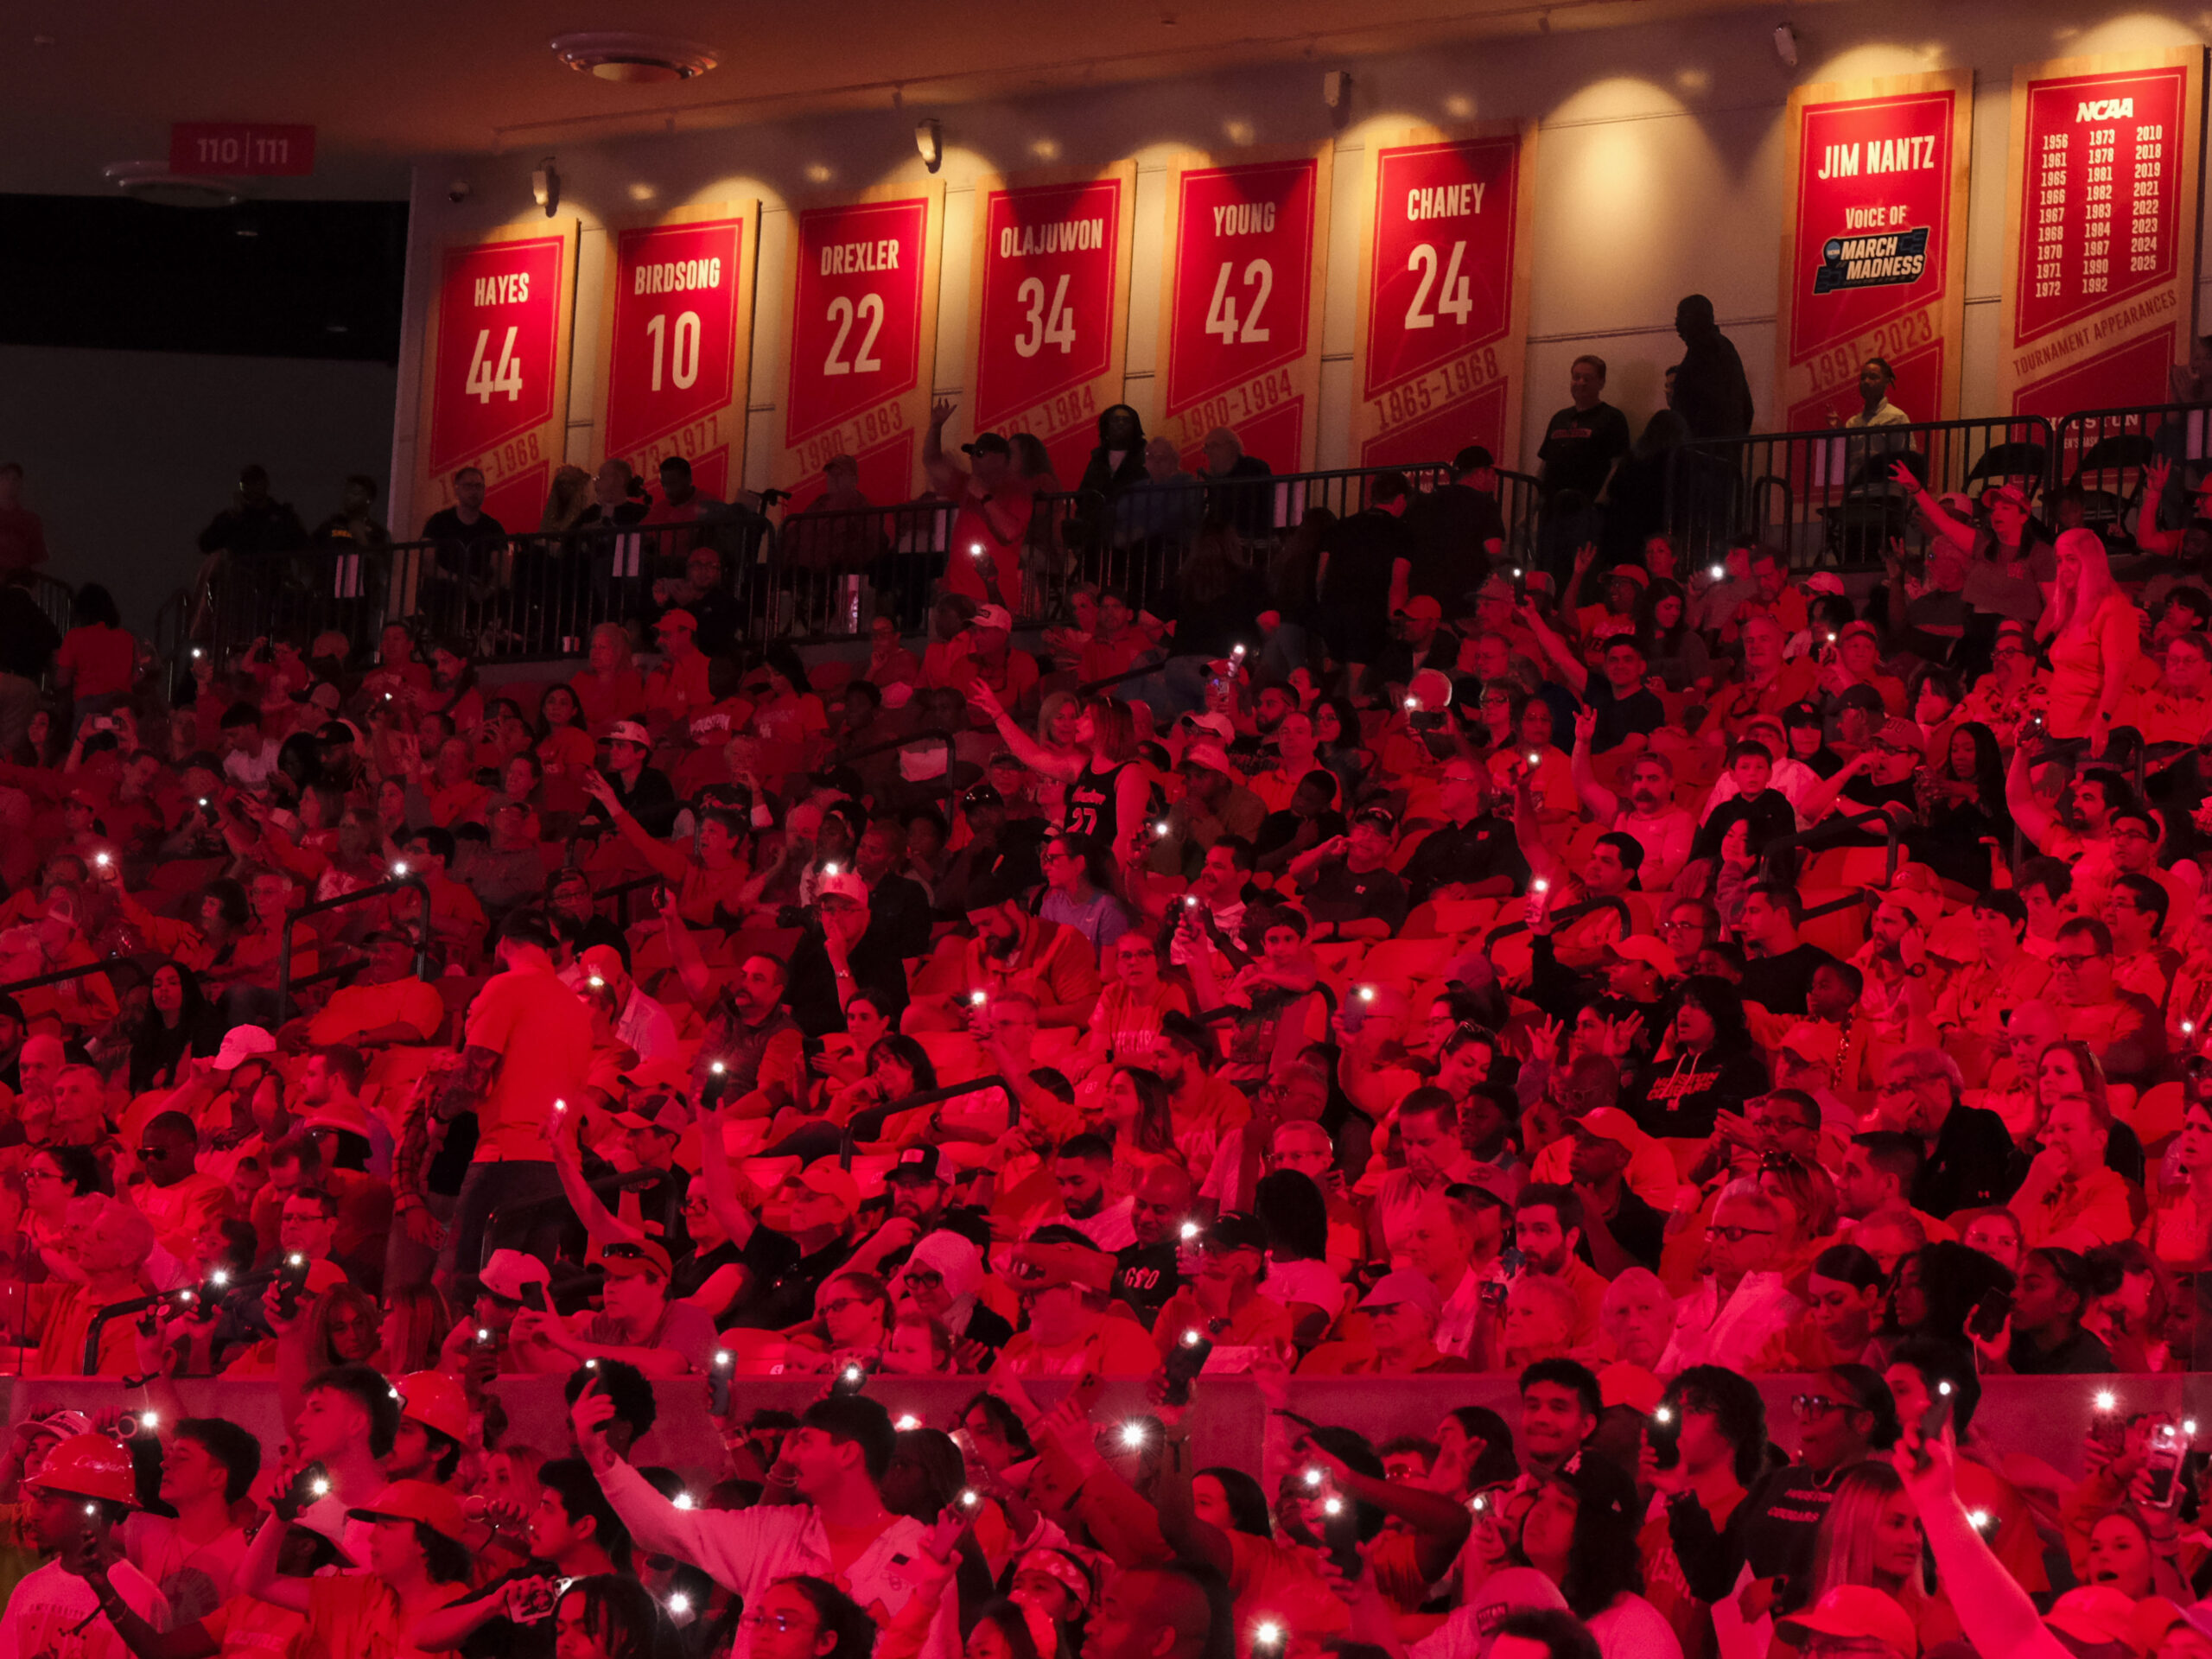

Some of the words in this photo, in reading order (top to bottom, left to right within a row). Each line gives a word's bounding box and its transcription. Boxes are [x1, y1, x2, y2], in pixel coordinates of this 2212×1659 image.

[2076, 98, 2133, 122] NCAA
[197, 138, 238, 163] 110
[256, 139, 288, 163] 111
[2043, 133, 2068, 150] 1956
[2089, 130, 2115, 147] 1973
[2136, 124, 2162, 142] 2010
[1819, 143, 1859, 179] JIM
[1866, 136, 1935, 174] NANTZ
[2042, 152, 2067, 169] 1961
[2088, 148, 2114, 165] 1978
[2135, 143, 2161, 161] 2018
[2041, 170, 2066, 188] 1965
[2088, 166, 2113, 183] 1981
[2134, 162, 2160, 180] 2019
[1408, 185, 1482, 220] CHANEY
[2040, 188, 2065, 206] 1966
[2087, 185, 2113, 201] 1982
[2133, 181, 2159, 198] 2021
[1214, 205, 1274, 236] YOUNG
[2039, 207, 2064, 224] 1967
[2086, 203, 2112, 220] 1983
[2133, 200, 2158, 216] 2022
[1001, 219, 1103, 257] OLAJUWON
[2038, 226, 2063, 242] 1968
[2084, 222, 2110, 238] 1984
[2132, 218, 2158, 235] 2023
[822, 239, 899, 275] DREXLER
[1840, 236, 1898, 260] MARCH
[2037, 244, 2063, 261] 1970
[2083, 240, 2109, 257] 1987
[2131, 237, 2157, 254] 2024
[636, 257, 721, 294] BIRDSONG
[1847, 255, 1925, 281] MADNESS
[2037, 263, 2062, 279] 1971
[2082, 259, 2108, 276] 1990
[2130, 256, 2156, 272] 2025
[475, 272, 529, 306] HAYES
[1205, 259, 1272, 344] 42
[1405, 241, 1471, 329] 24
[2036, 281, 2062, 297] 1972
[2082, 277, 2107, 294] 1992
[1015, 274, 1076, 357] 34
[824, 294, 884, 375] 22
[2012, 327, 2090, 377] TOURNAMENT
[2093, 289, 2177, 340] APPEARANCES
[467, 327, 522, 403] 44
[648, 311, 701, 391] 10
[1805, 309, 1933, 392] 1991-2023
[1180, 368, 1293, 442] 1980-1984
[796, 401, 903, 475] 1980-1983
